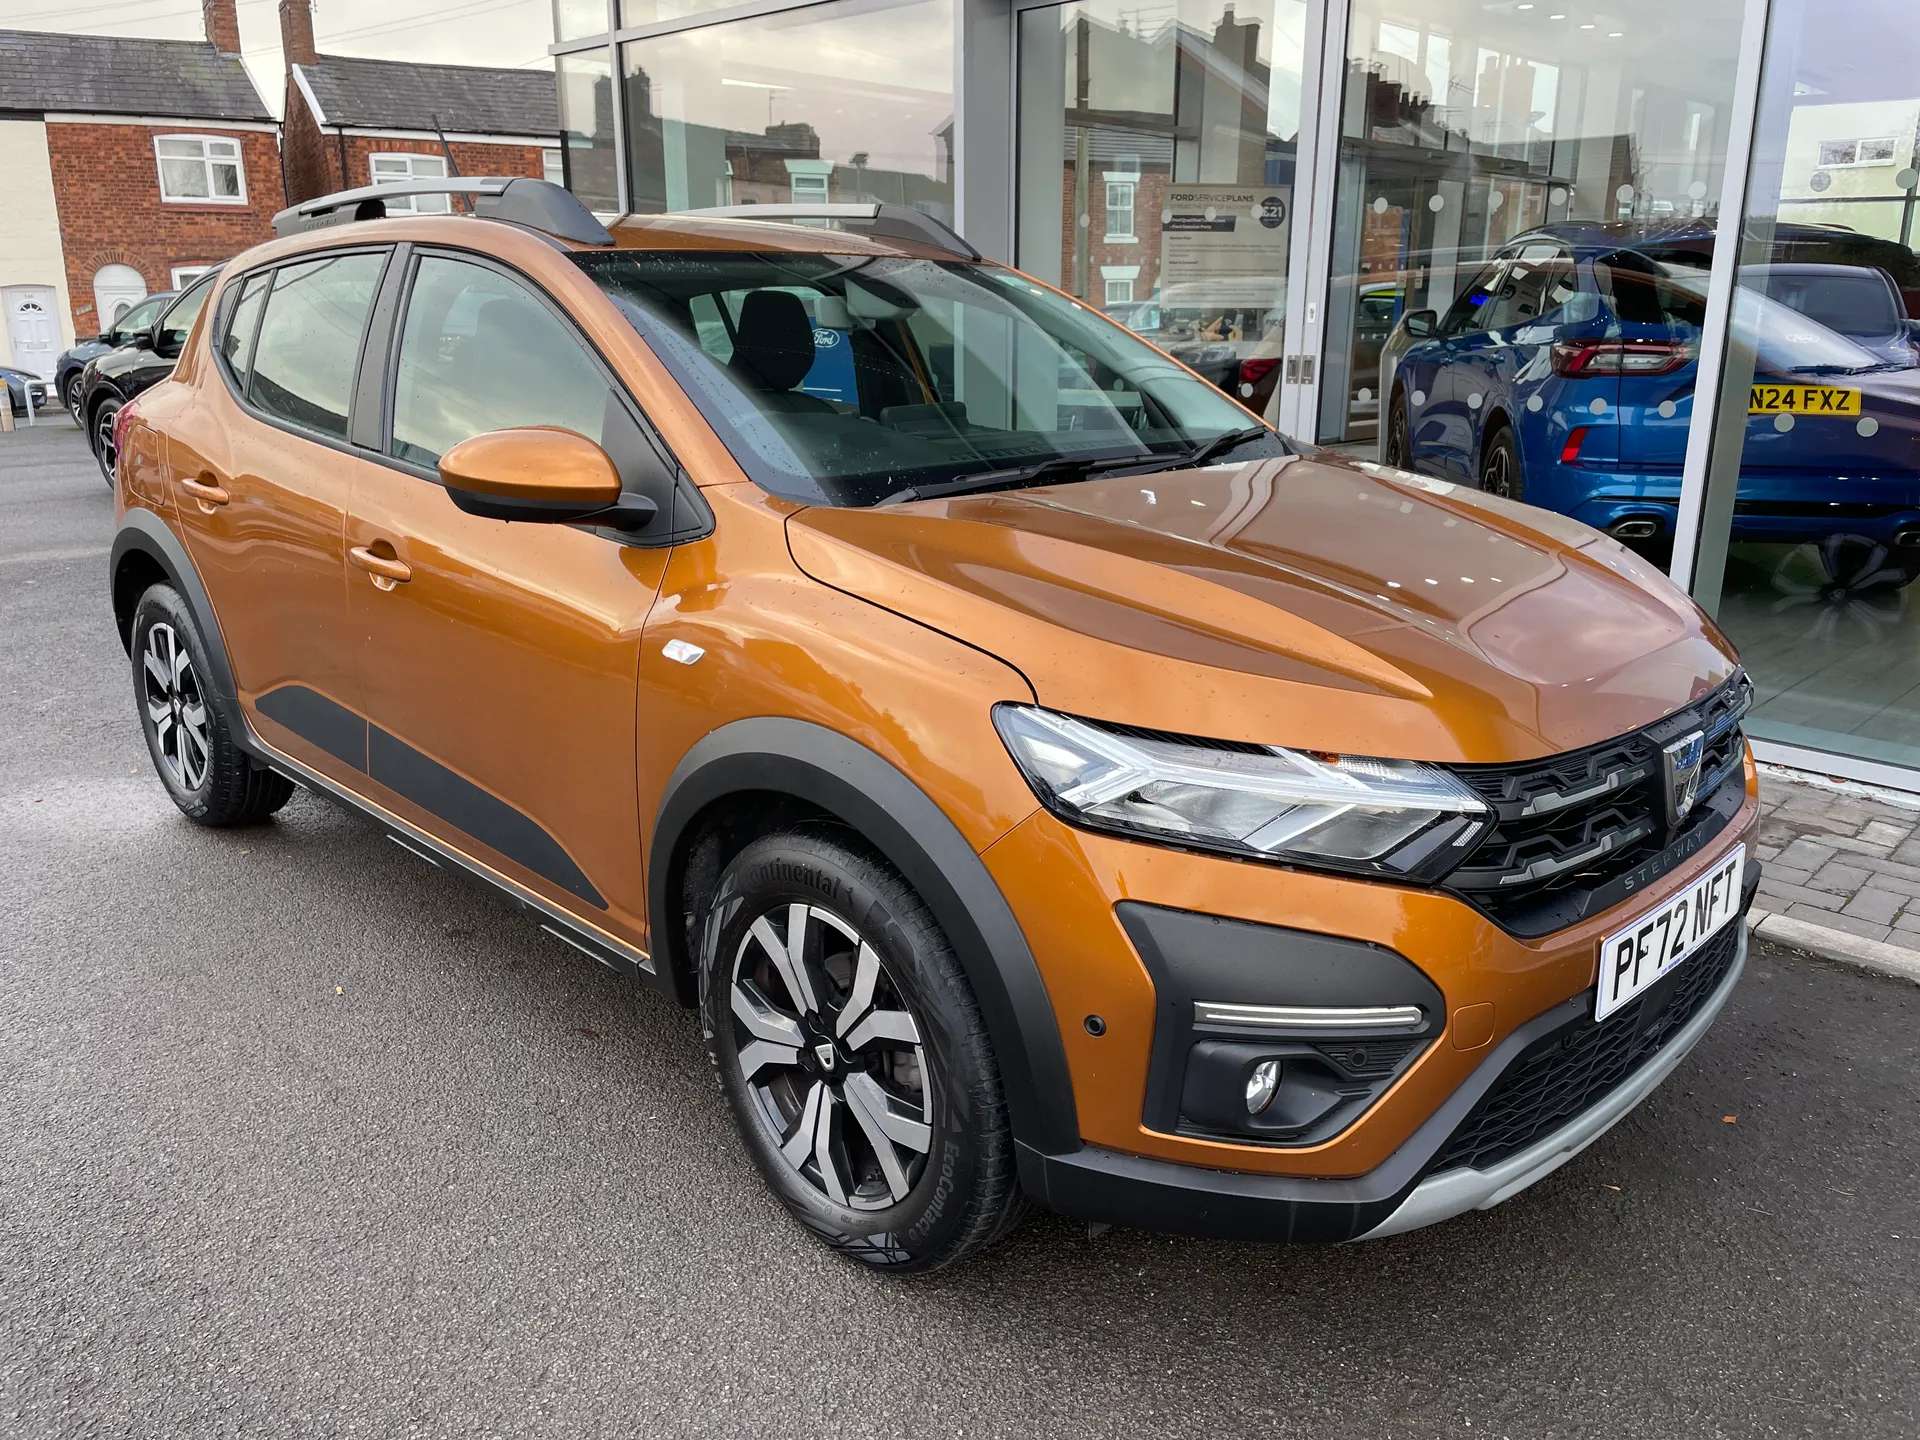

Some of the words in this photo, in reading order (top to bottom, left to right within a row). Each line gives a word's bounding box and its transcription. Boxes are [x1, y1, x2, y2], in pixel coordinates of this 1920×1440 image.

[1749, 388, 1796, 409] N24
[1803, 389, 1850, 411] FXZ
[744, 857, 841, 899] ontinental
[1624, 831, 1703, 890] STEPWAY
[1612, 899, 1688, 1002] PF72
[1691, 860, 1737, 943] NFT
